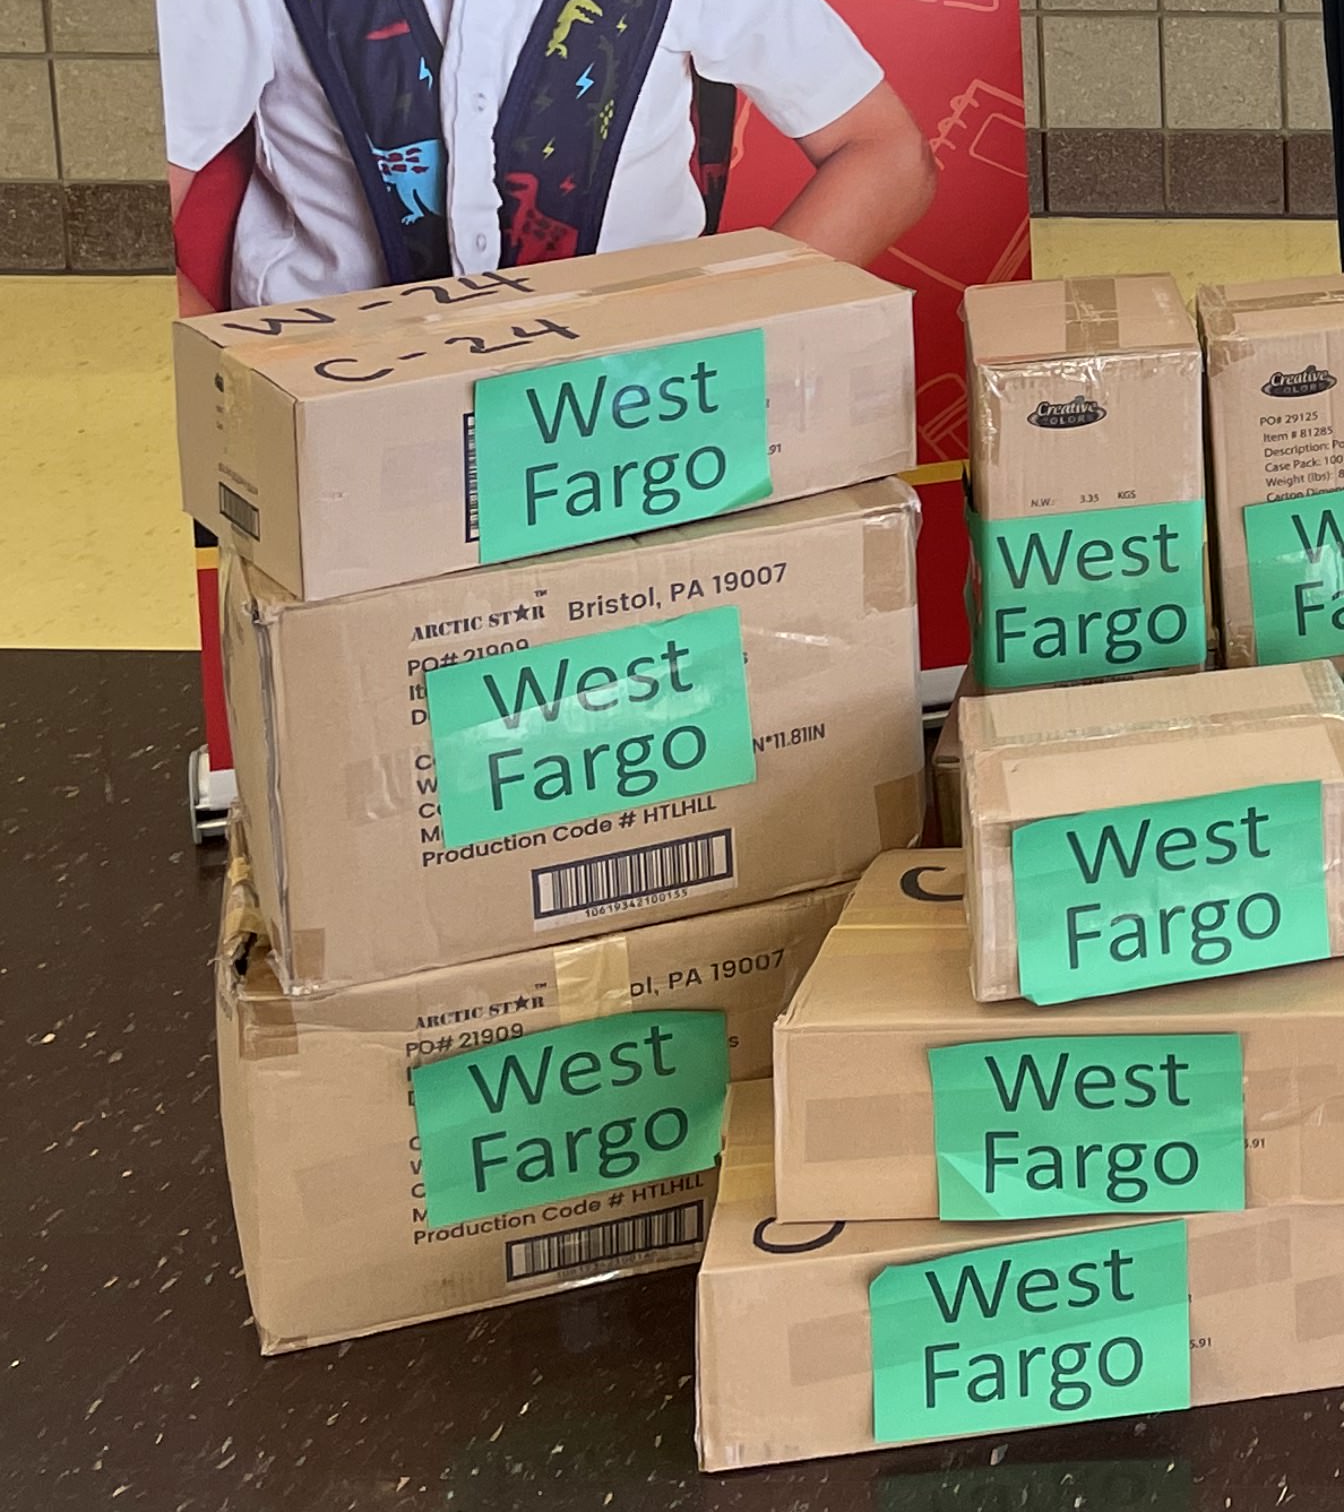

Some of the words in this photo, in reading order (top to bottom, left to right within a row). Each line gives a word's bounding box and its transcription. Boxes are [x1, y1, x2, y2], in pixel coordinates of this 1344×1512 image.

[527, 361, 719, 444] West
[1270, 366, 1329, 387] Creative
[1260, 415, 1282, 426] PO#
[1285, 411, 1319, 424] 29125
[1263, 432, 1289, 443] Item
[1300, 426, 1333, 439] 81285
[1264, 442, 1329, 458] Description:
[523, 444, 725, 525] Fargo
[1265, 461, 1291, 473] Case
[1324, 455, 1344, 465] 100
[1266, 474, 1304, 488] Weight
[997, 523, 1179, 589] West
[568, 586, 662, 621] Bristol,
[670, 579, 705, 603] PA
[712, 562, 787, 595] 19007
[411, 615, 483, 642] ARCTIC
[996, 601, 1187, 664] Fargo
[407, 653, 459, 676] PO#
[484, 639, 693, 728] West
[489, 723, 706, 811] Fargo
[422, 833, 547, 868] Production
[552, 817, 612, 842] Code
[643, 795, 717, 825] HTLHLL
[1067, 806, 1271, 885] West
[1068, 890, 1282, 970] Fargo
[668, 969, 702, 991] PA
[710, 949, 784, 983] 19007
[406, 1036, 453, 1058] PO#
[458, 1022, 525, 1050] 21909
[415, 1005, 484, 1031] ARCTIC
[469, 1025, 675, 1114] West
[986, 1051, 1191, 1112] West
[472, 1105, 688, 1193] Fargo
[984, 1131, 1199, 1204] Fargo
[413, 1211, 537, 1245] Production
[542, 1197, 601, 1222] Code
[632, 1173, 704, 1203] HTLHLL
[926, 1249, 1136, 1325] West
[923, 1333, 1144, 1411] Fargo
